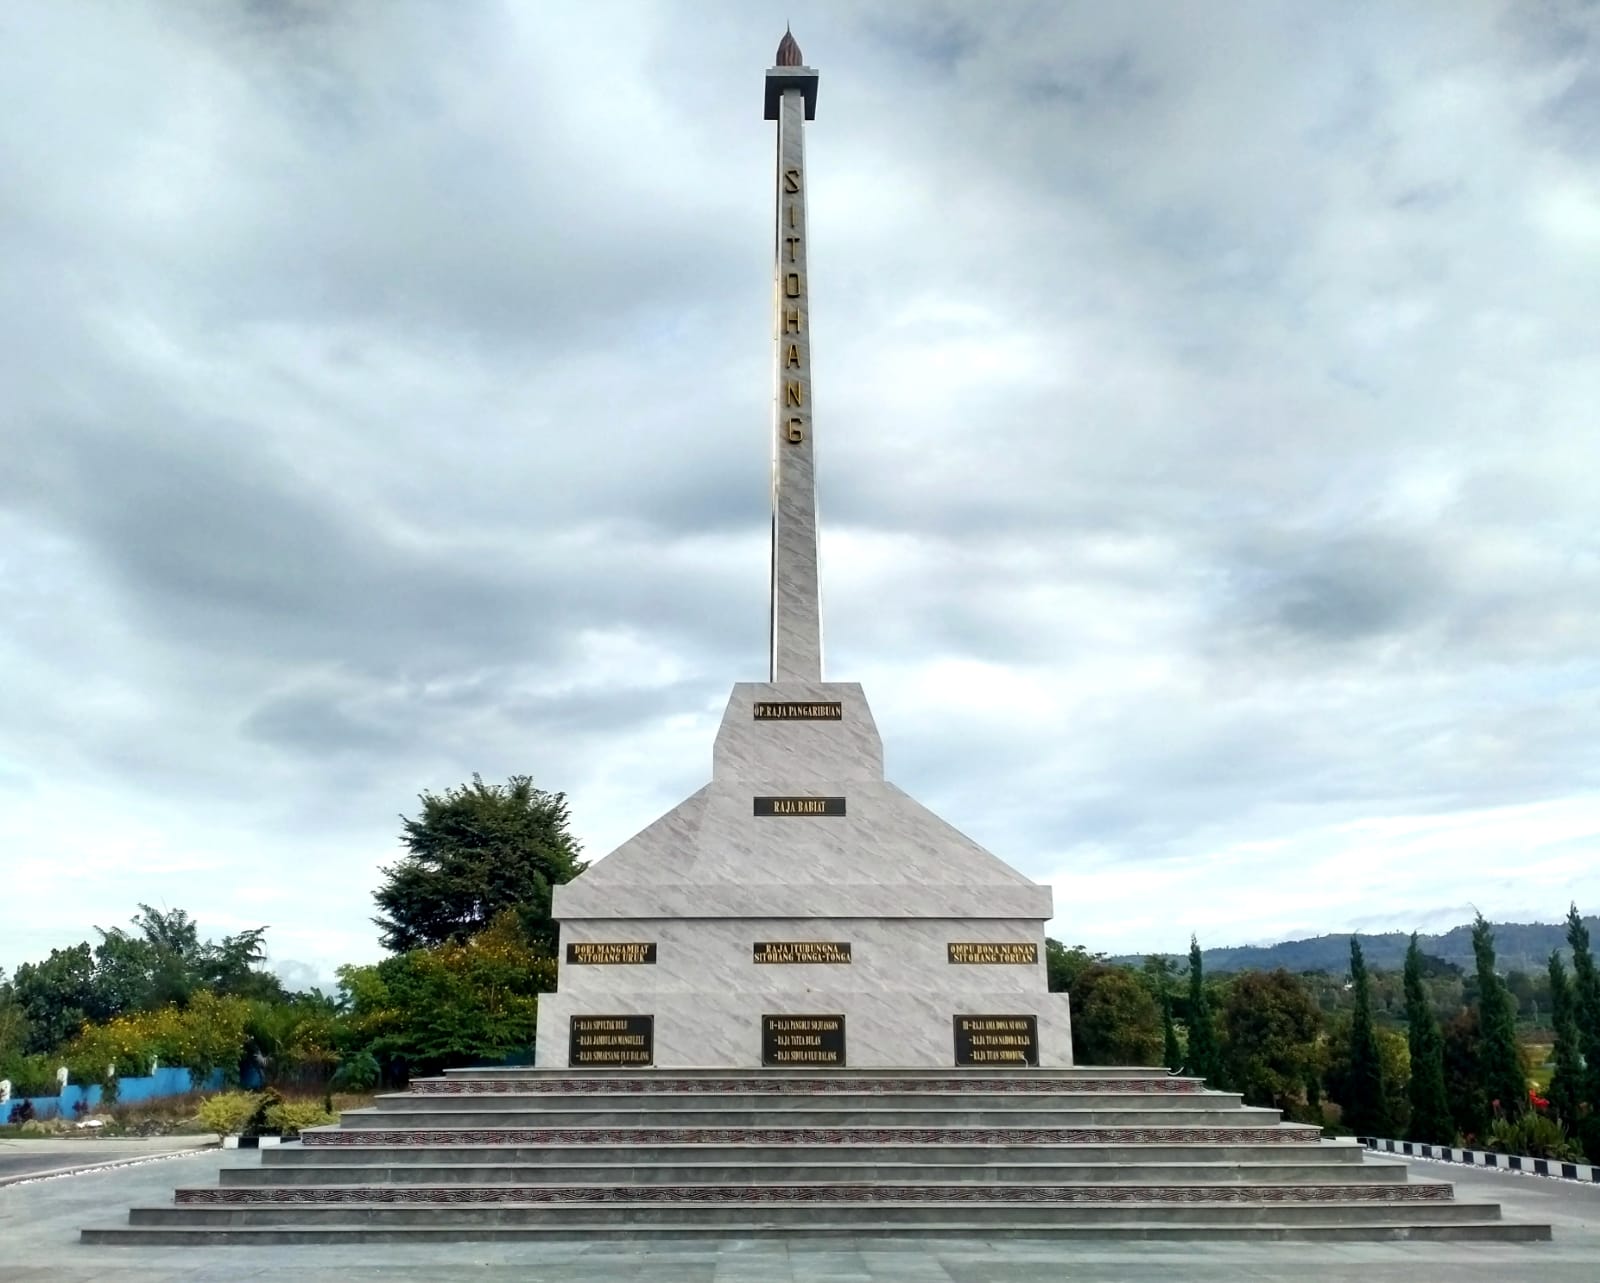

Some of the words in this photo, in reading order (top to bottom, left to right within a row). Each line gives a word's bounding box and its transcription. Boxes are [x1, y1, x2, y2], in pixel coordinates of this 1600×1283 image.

[785, 170, 804, 444] SITOHANG
[789, 705, 840, 717] PANGARIBUAN
[774, 801, 796, 813] RAJA
[798, 801, 826, 813] BABIAT
[597, 944, 648, 954] MANGAMBAT
[766, 944, 788, 953] RAJA
[950, 945, 974, 953] OMPU
[1012, 945, 1035, 953] ONAN
[578, 953, 620, 962] SITOHANG
[623, 953, 644, 962] URUK
[754, 952, 794, 962] SITOHANG
[797, 952, 851, 962] TONGA-TONGA
[954, 953, 996, 962] SITOHANG
[999, 953, 1032, 962] TORUAN
